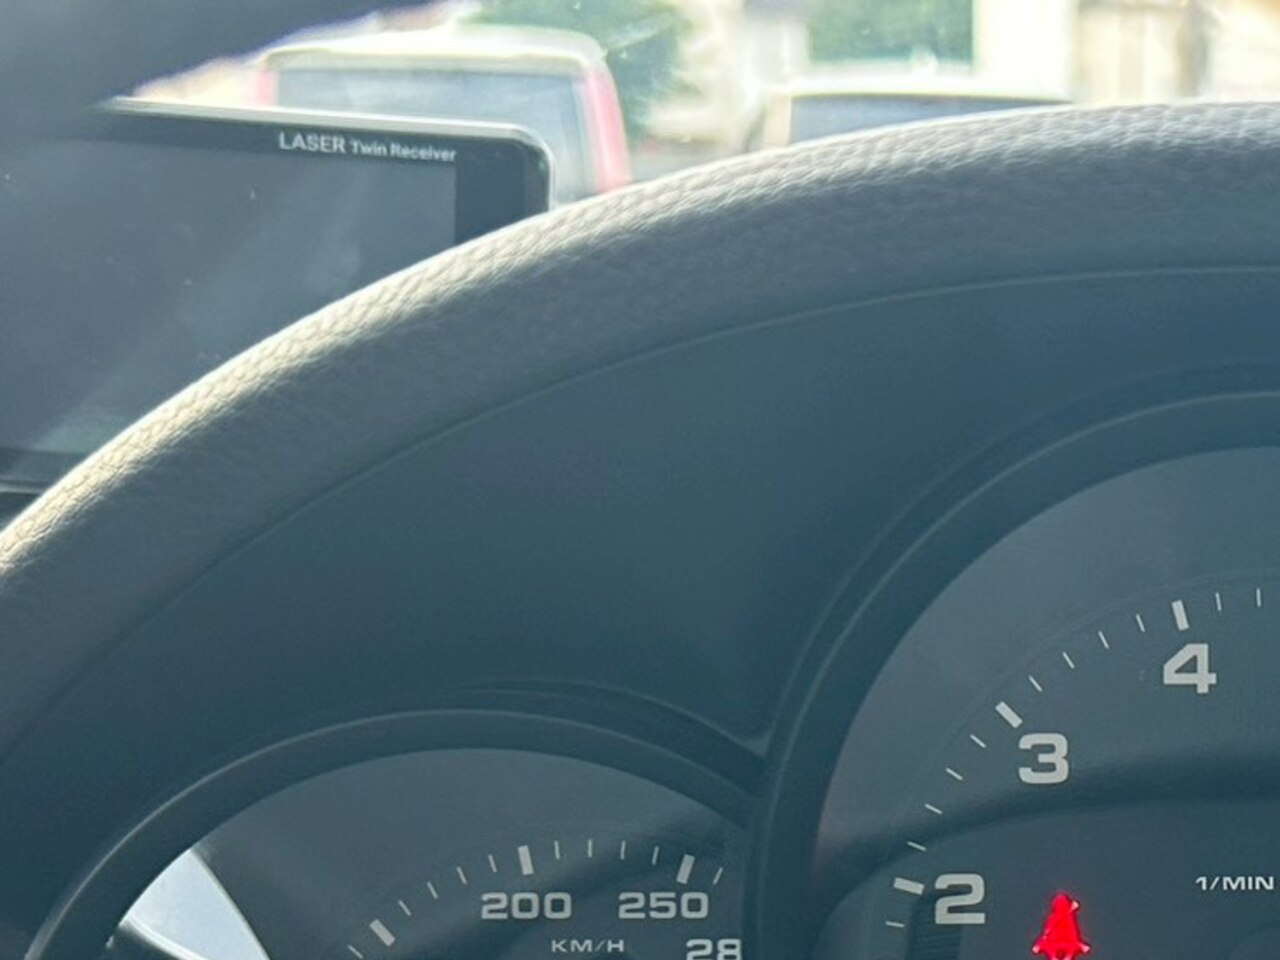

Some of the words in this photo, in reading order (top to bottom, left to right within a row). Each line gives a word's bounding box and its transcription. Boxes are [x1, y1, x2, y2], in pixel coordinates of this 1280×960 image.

[279, 131, 346, 154] LASER
[351, 140, 387, 155] Twin
[390, 143, 455, 161] Receiver
[1164, 644, 1216, 693] 4
[1019, 733, 1068, 783] 3
[1196, 877, 1273, 890] 1/MIN
[481, 892, 571, 919] 200
[619, 892, 708, 918] 250
[935, 874, 985, 924] 2
[552, 940, 624, 952] KM/H
